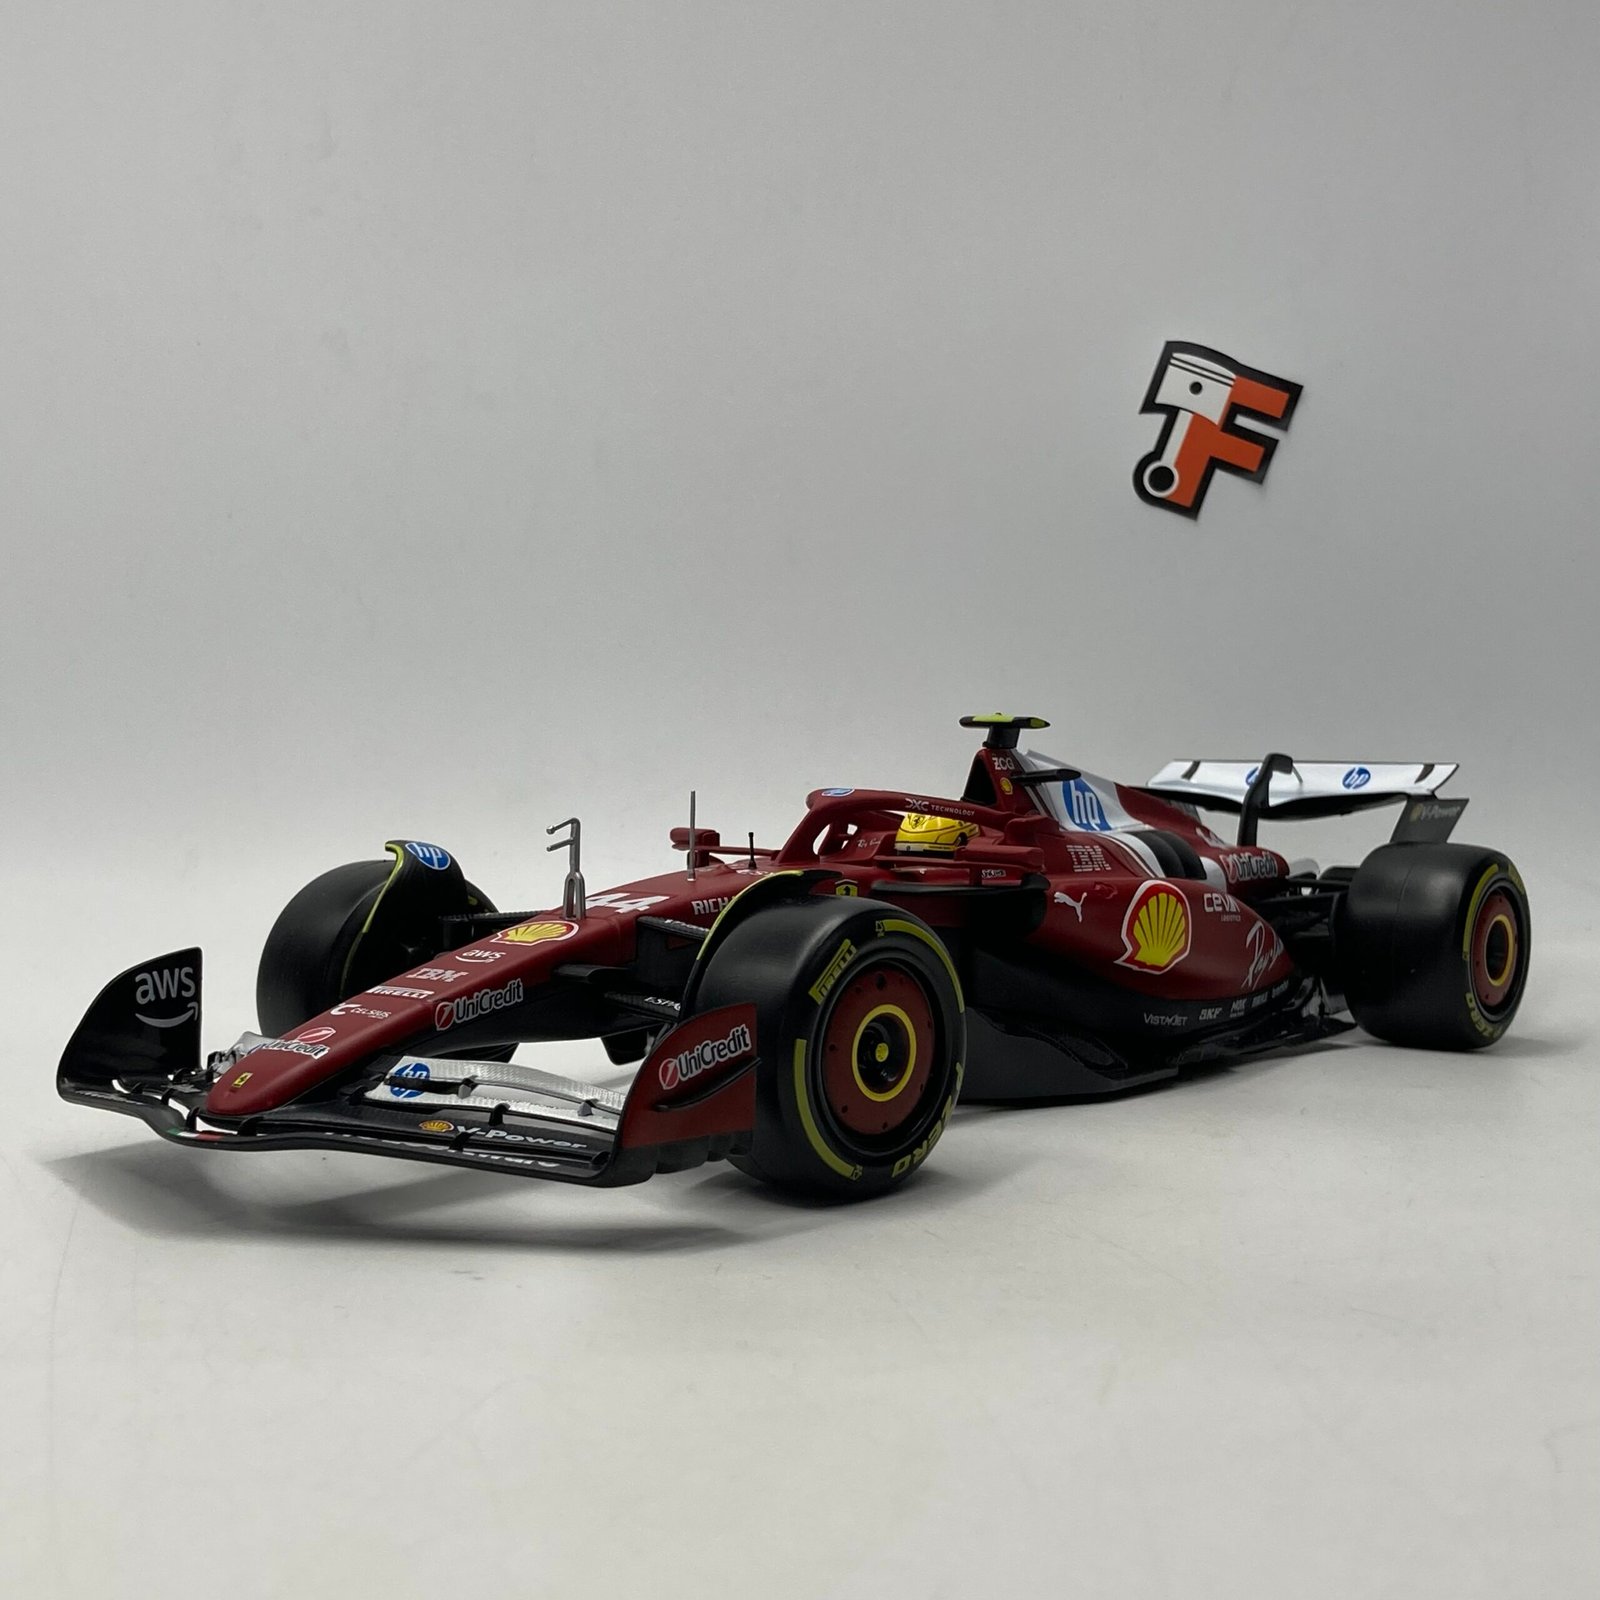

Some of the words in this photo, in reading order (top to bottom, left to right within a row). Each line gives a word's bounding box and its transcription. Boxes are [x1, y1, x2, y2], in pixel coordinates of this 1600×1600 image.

[1345, 767, 1369, 789] hp
[905, 798, 929, 811] DXC
[931, 804, 975, 816] TECHNOLOGY
[1069, 779, 1104, 831] hp
[410, 842, 445, 868] hp
[1066, 845, 1111, 872] IBM
[463, 949, 507, 959] aws
[405, 967, 469, 983] IBM
[808, 938, 858, 1005] PIRELLI
[135, 966, 197, 1005] aws
[455, 979, 523, 1023] UniCredit
[679, 1024, 751, 1080] UniCredit
[456, 1124, 588, 1149] V-Power
[891, 1095, 953, 1178] ZERO
